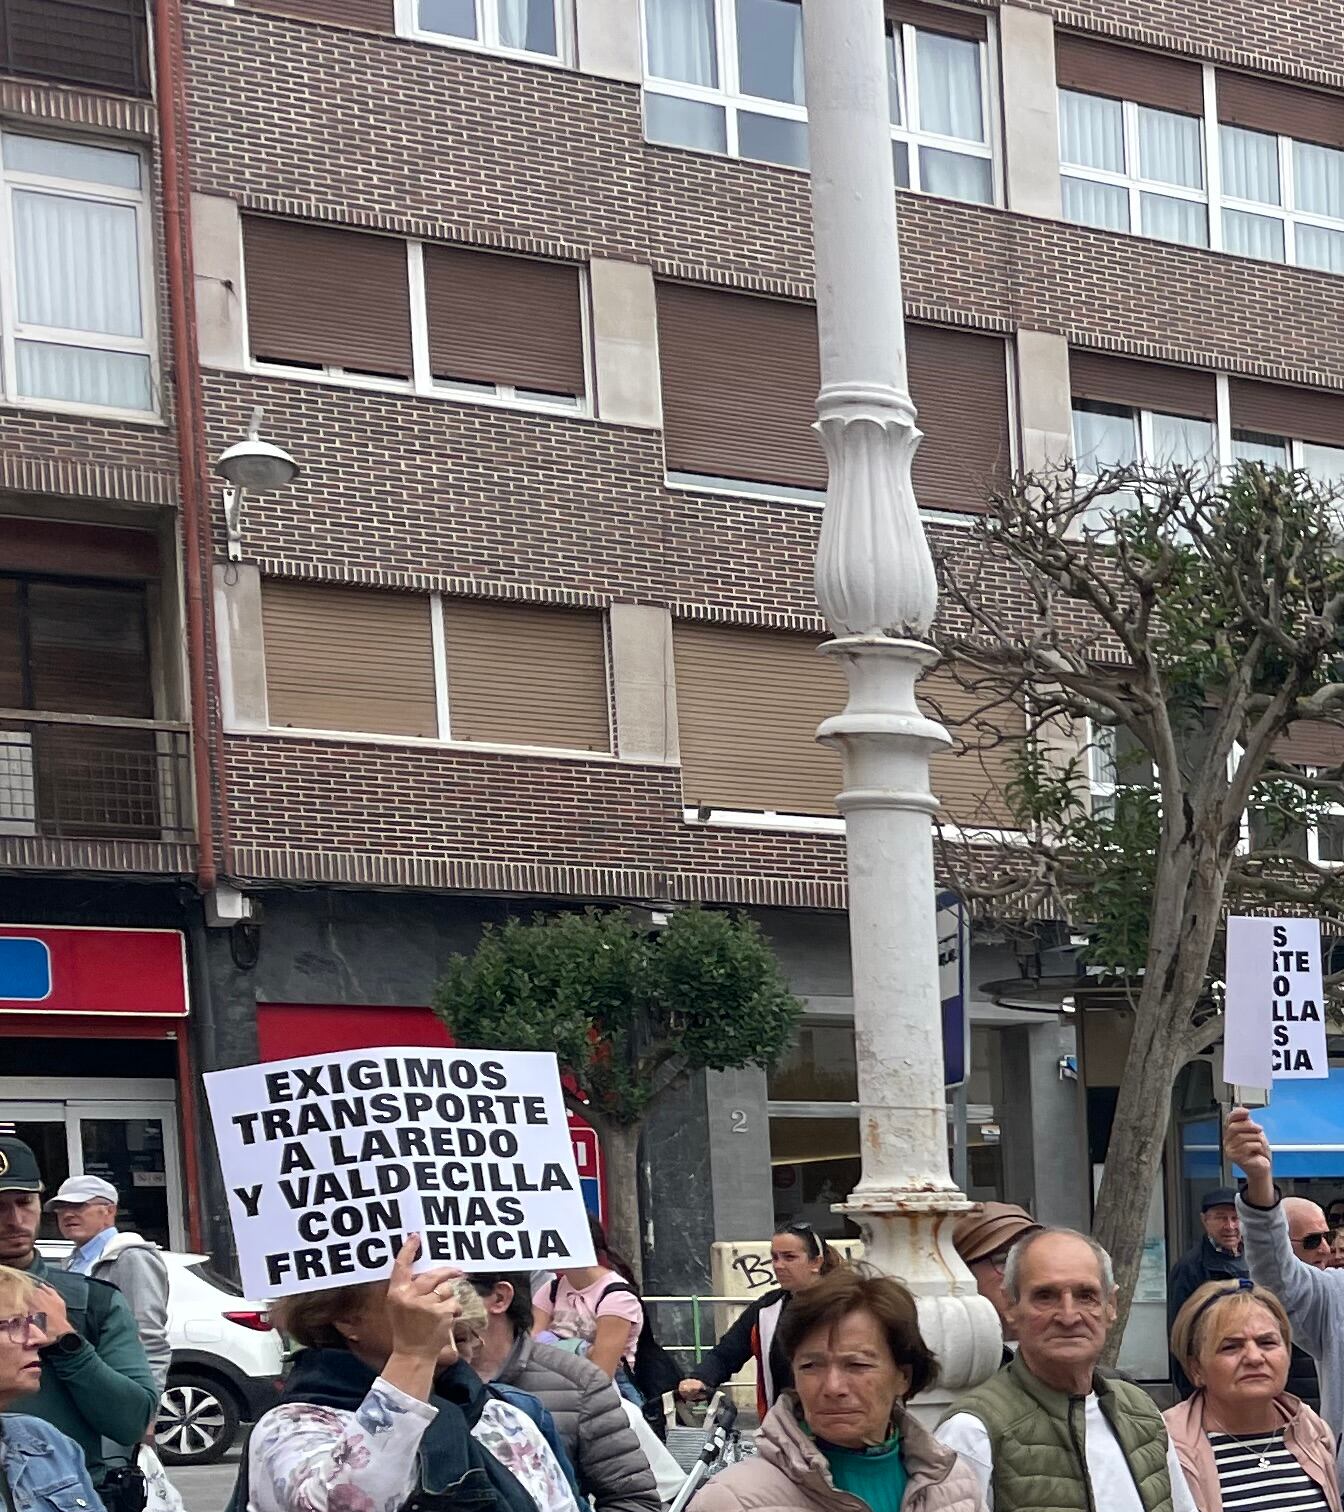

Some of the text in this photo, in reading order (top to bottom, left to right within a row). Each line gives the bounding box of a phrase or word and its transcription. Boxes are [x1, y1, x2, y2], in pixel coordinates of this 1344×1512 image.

[265, 1058, 507, 1104] EXIGIMOS
[232, 1093, 549, 1145] TRANSPORTE
[730, 1110, 749, 1133] 2
[279, 1127, 518, 1175] A LAREDO
[233, 1162, 573, 1218] Y VALDECILLA
[298, 1196, 525, 1242] CON MAS
